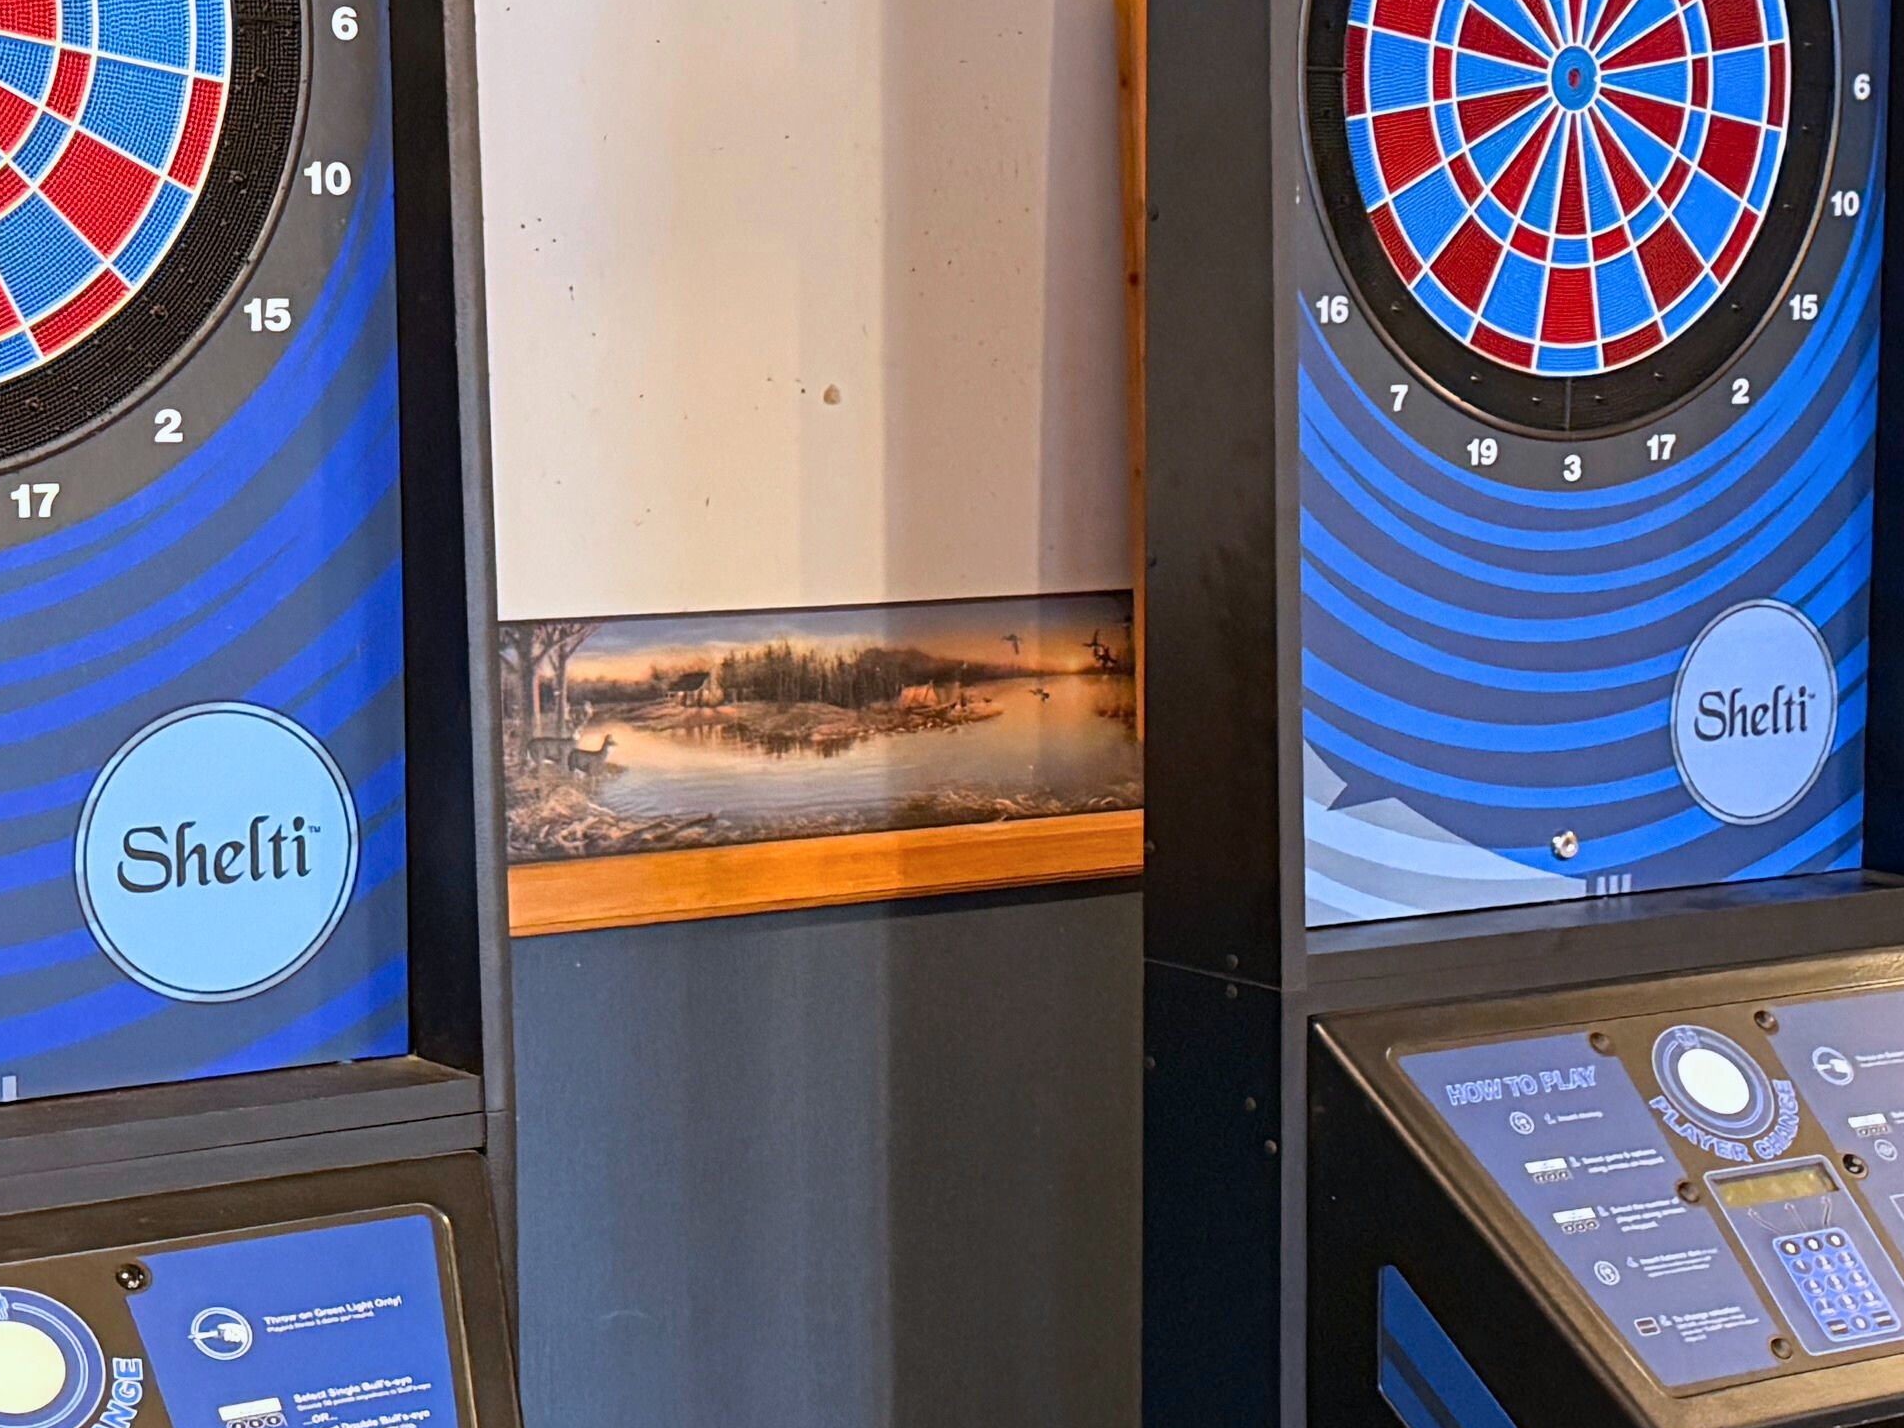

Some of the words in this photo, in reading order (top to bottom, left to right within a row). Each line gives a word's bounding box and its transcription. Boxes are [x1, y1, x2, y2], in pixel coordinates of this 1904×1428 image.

[332, 7, 358, 41] 6
[1854, 74, 1870, 100] 6
[303, 163, 352, 196] 10
[1832, 190, 1859, 217] 10
[243, 299, 292, 333] 15
[1316, 295, 1349, 323] 16
[1790, 294, 1818, 320] 15
[1390, 384, 1408, 411] 7
[1732, 378, 1749, 404] 2
[154, 410, 183, 445] 2
[1467, 438, 1498, 465] 19
[1647, 434, 1676, 460] 17
[1563, 453, 1581, 481] 3
[10, 484, 61, 519] 17
[1446, 1078, 1502, 1106] HOW
[1503, 1074, 1538, 1097] TO
[1540, 1065, 1596, 1092] PLAY
[1649, 1095, 1753, 1162] PLAYER
[1753, 1079, 1799, 1159] CHANGE
